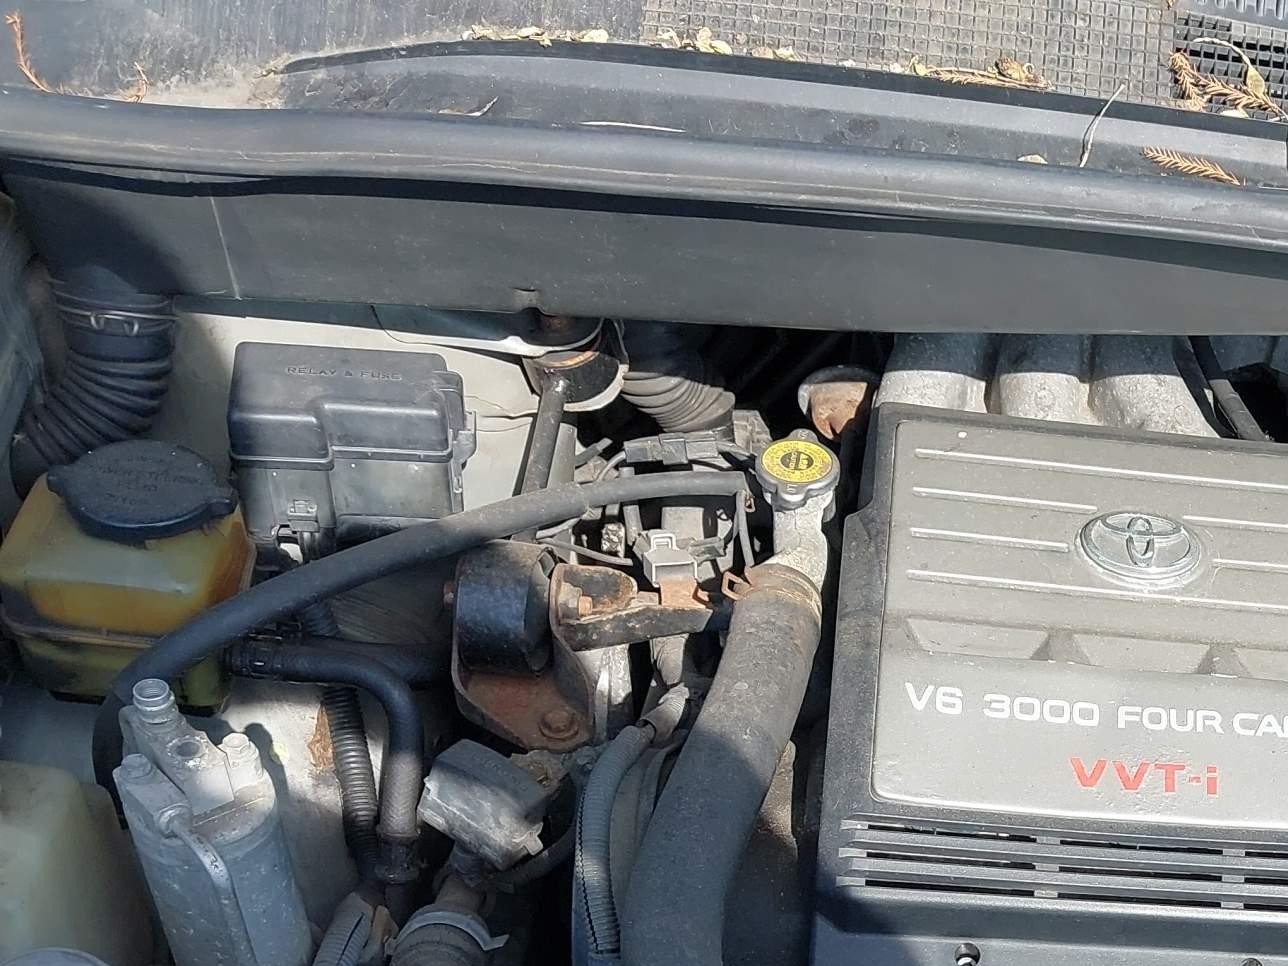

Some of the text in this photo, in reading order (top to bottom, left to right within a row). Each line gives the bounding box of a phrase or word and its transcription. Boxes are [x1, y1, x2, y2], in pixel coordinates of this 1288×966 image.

[285, 366, 337, 376] RELAY
[904, 682, 963, 715] V6
[983, 693, 1100, 727] 3000
[1116, 704, 1225, 734] FOUR
[1069, 755, 1219, 797] VVT-i
